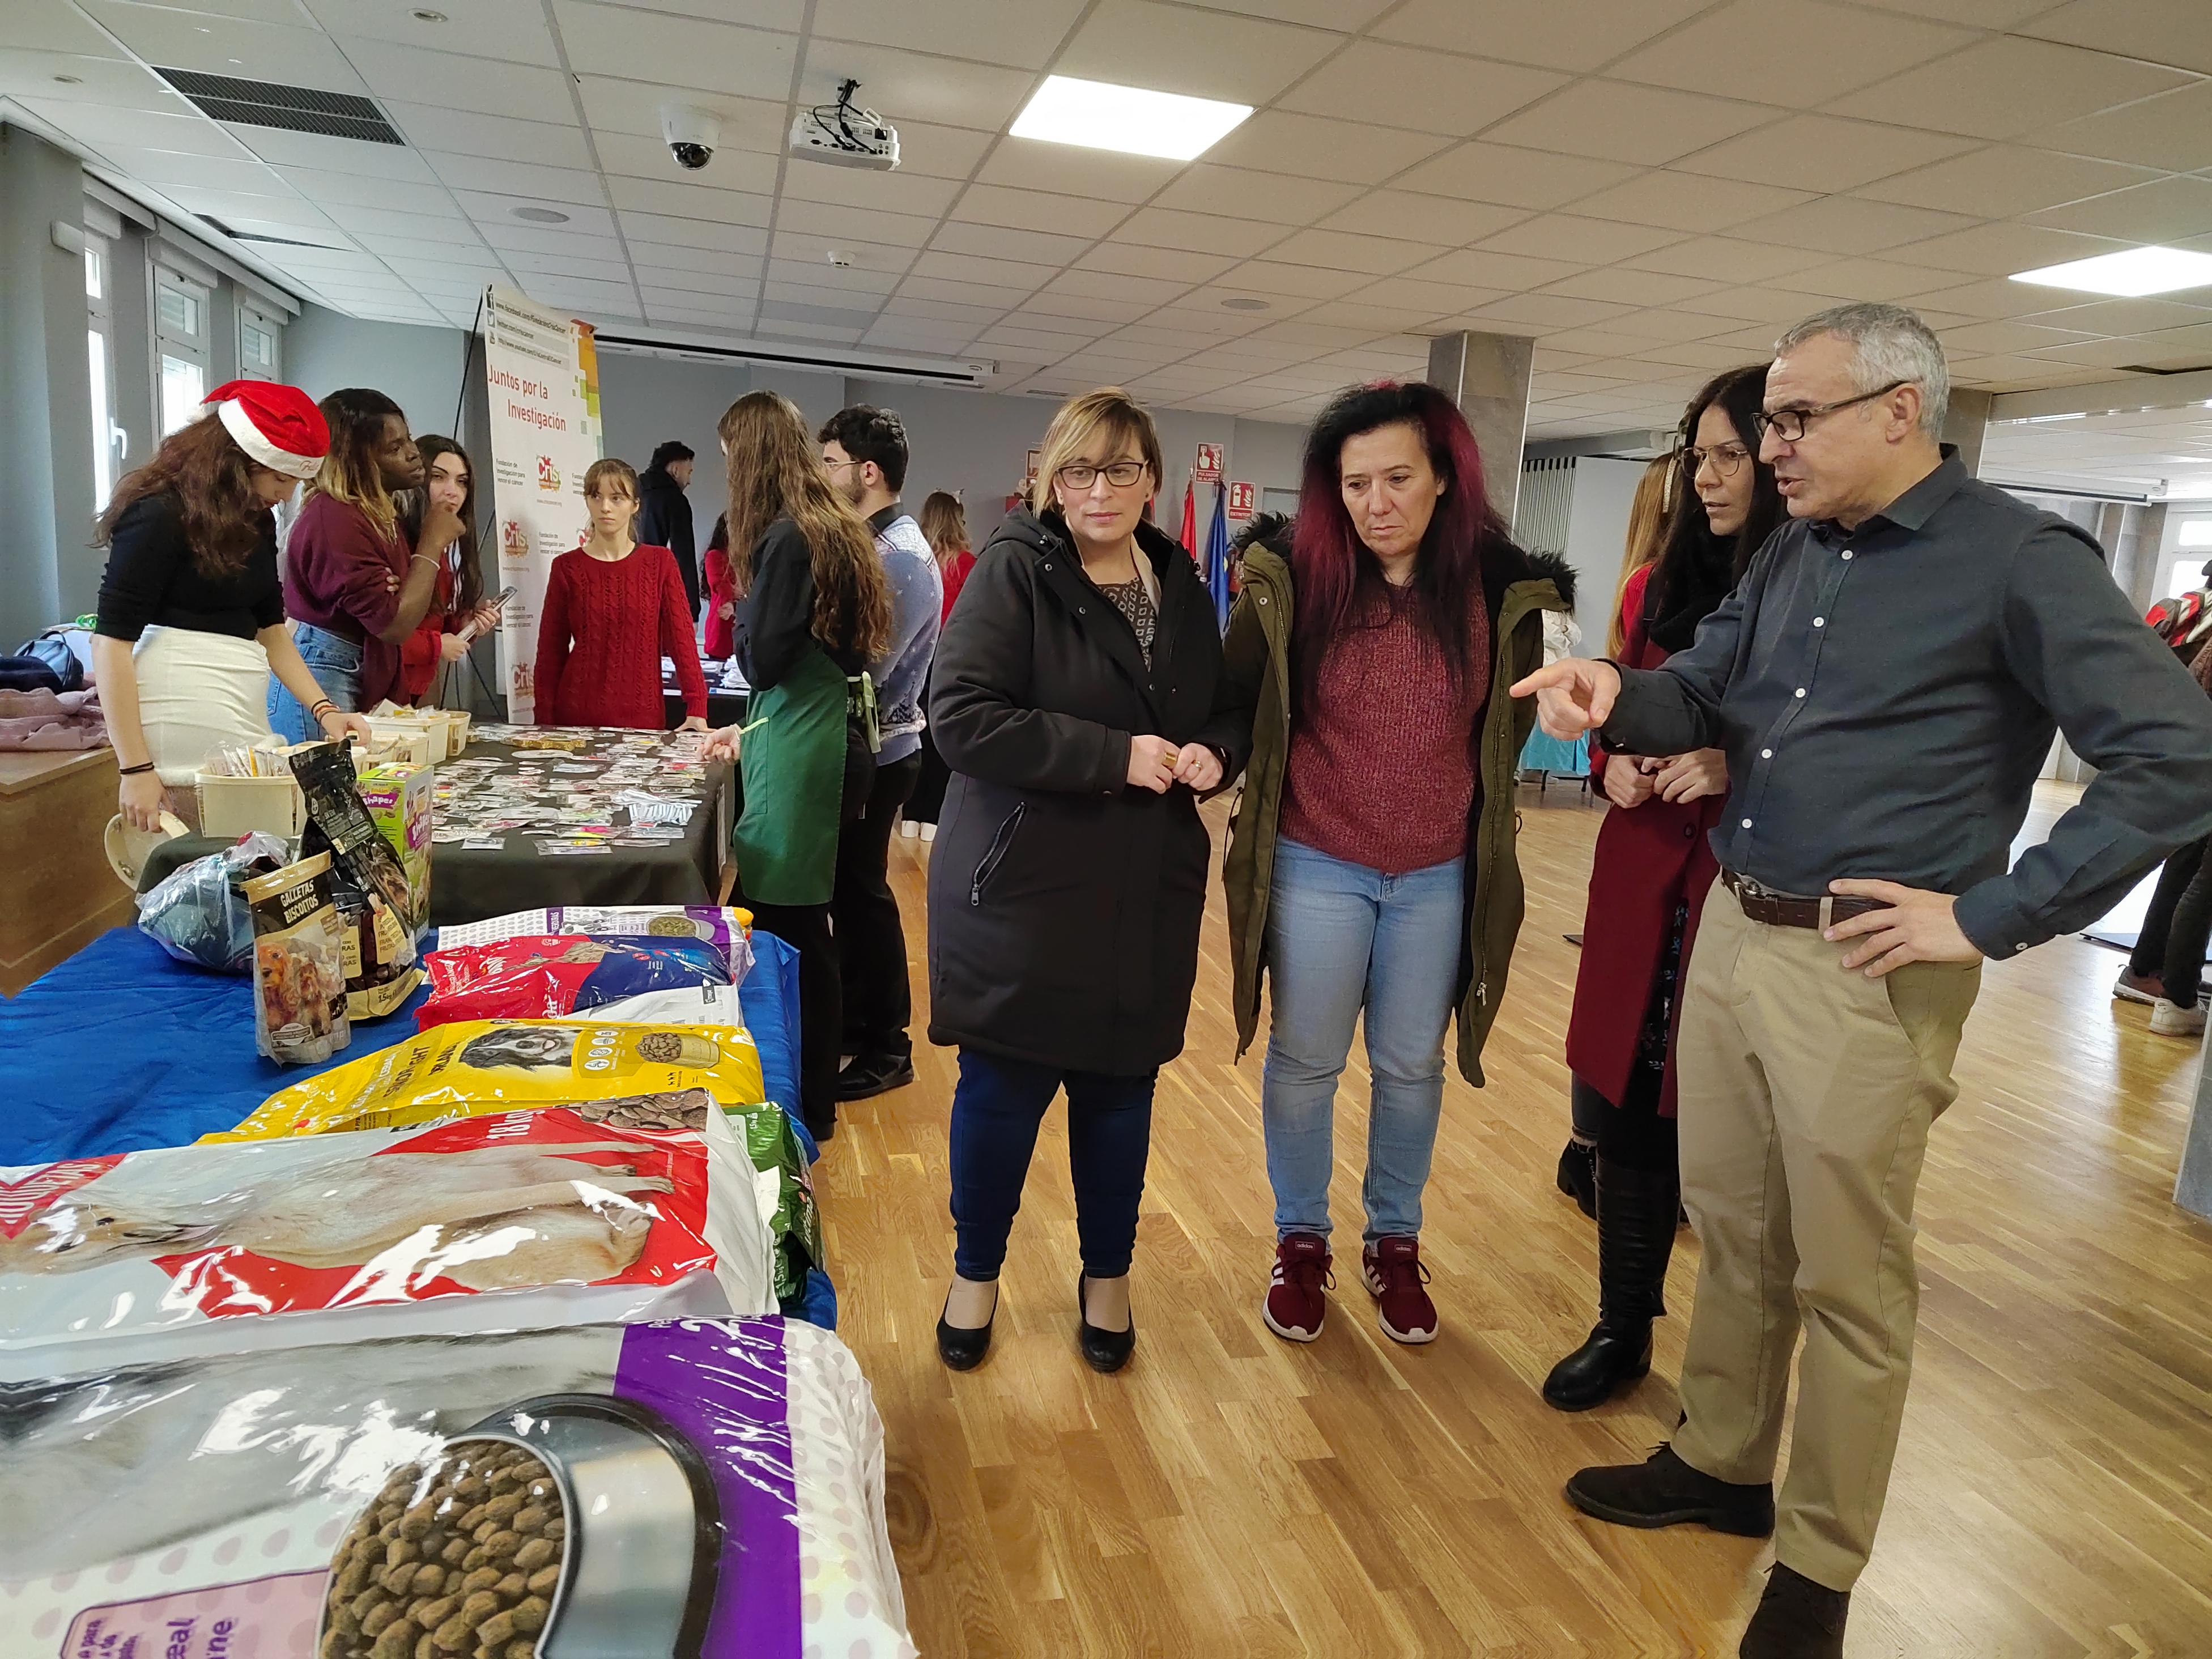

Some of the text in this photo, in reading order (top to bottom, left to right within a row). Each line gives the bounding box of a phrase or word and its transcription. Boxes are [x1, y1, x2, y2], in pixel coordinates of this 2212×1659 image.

[488, 364, 548, 400] Juntos por la
[507, 398, 567, 432] Investigación
[280, 879, 314, 908] GALLETAS
[283, 894, 318, 924] BISCOITOS
